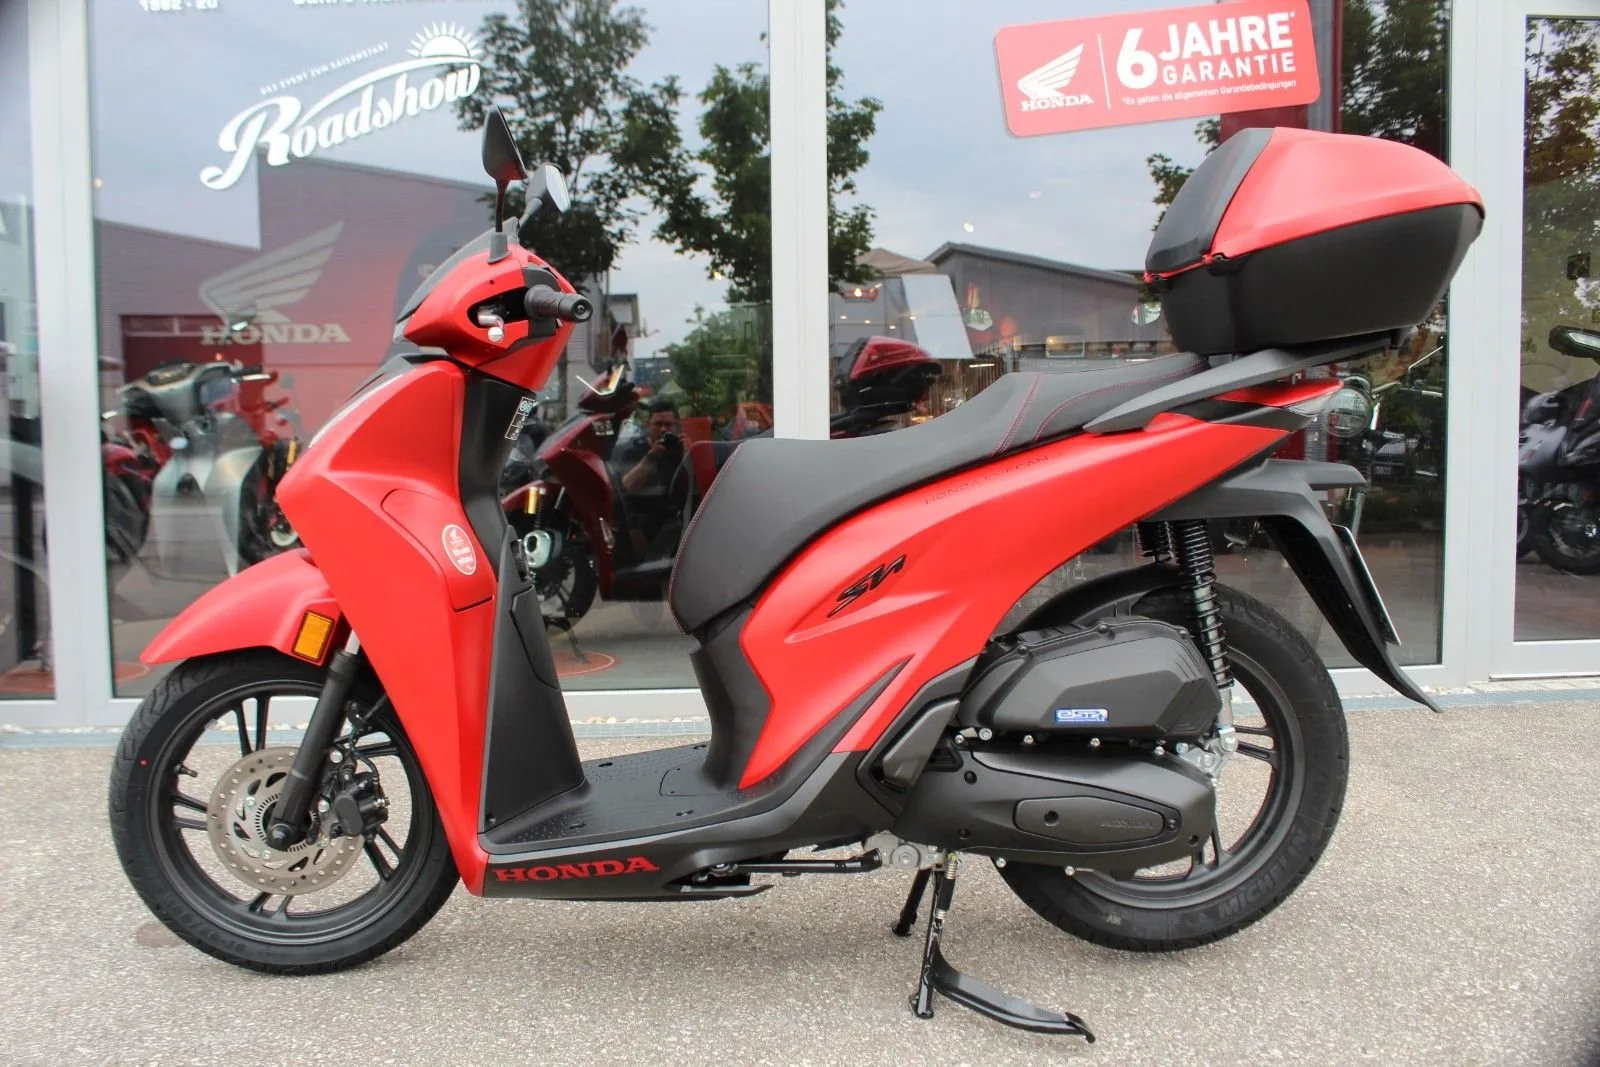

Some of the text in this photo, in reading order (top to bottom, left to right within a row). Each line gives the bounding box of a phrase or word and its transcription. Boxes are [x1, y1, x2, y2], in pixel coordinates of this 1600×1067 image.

[1116, 27, 1158, 89] 6
[1162, 51, 1296, 85] GARANTIE
[1021, 93, 1095, 112] HONDA
[200, 62, 481, 190] Roadshow
[201, 322, 351, 345] HONDA
[492, 855, 661, 882] HONDA
